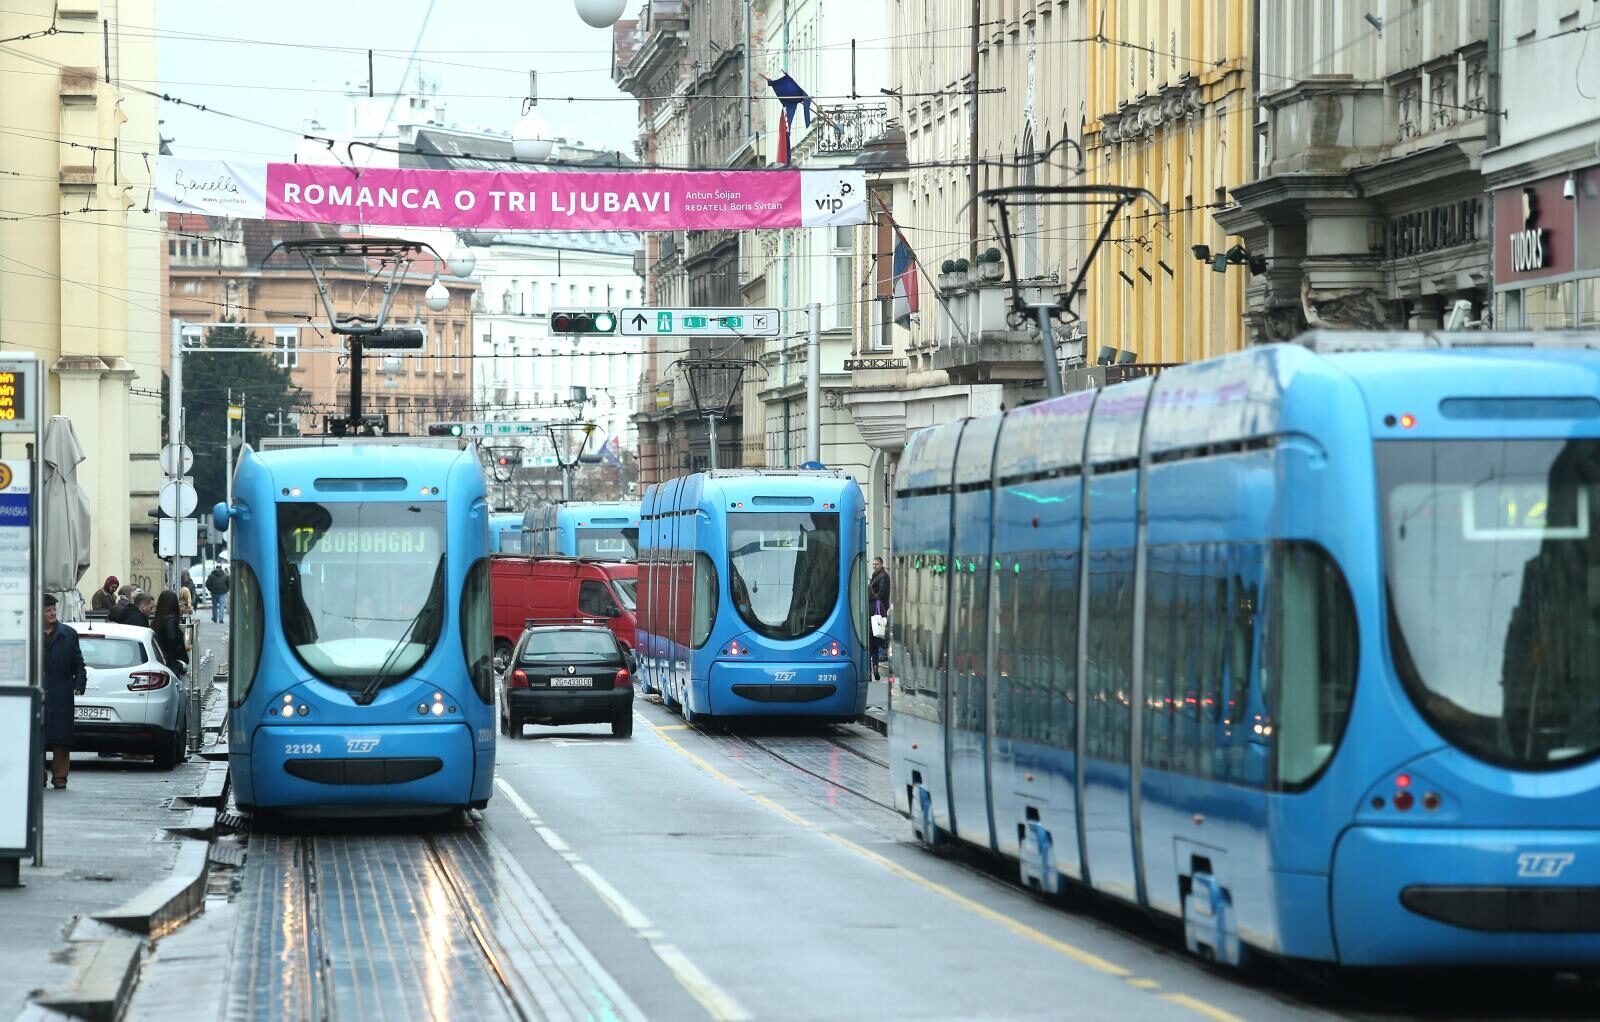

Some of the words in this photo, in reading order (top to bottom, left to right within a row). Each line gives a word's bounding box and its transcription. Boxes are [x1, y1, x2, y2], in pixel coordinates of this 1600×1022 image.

[283, 182, 442, 210] ROMANCA
[454, 190, 476, 211] O
[488, 191, 537, 212] TRI
[551, 191, 671, 217] LJUBAVI
[685, 191, 713, 200] Antun
[714, 189, 741, 201] Šoljan
[815, 193, 844, 214] vip
[684, 204, 728, 212] REDATELJ
[730, 202, 752, 211] Boris
[753, 201, 783, 211] Svrtan
[1509, 227, 1543, 273] TUDORS
[293, 527, 314, 553] 17
[284, 743, 322, 755] 22124
